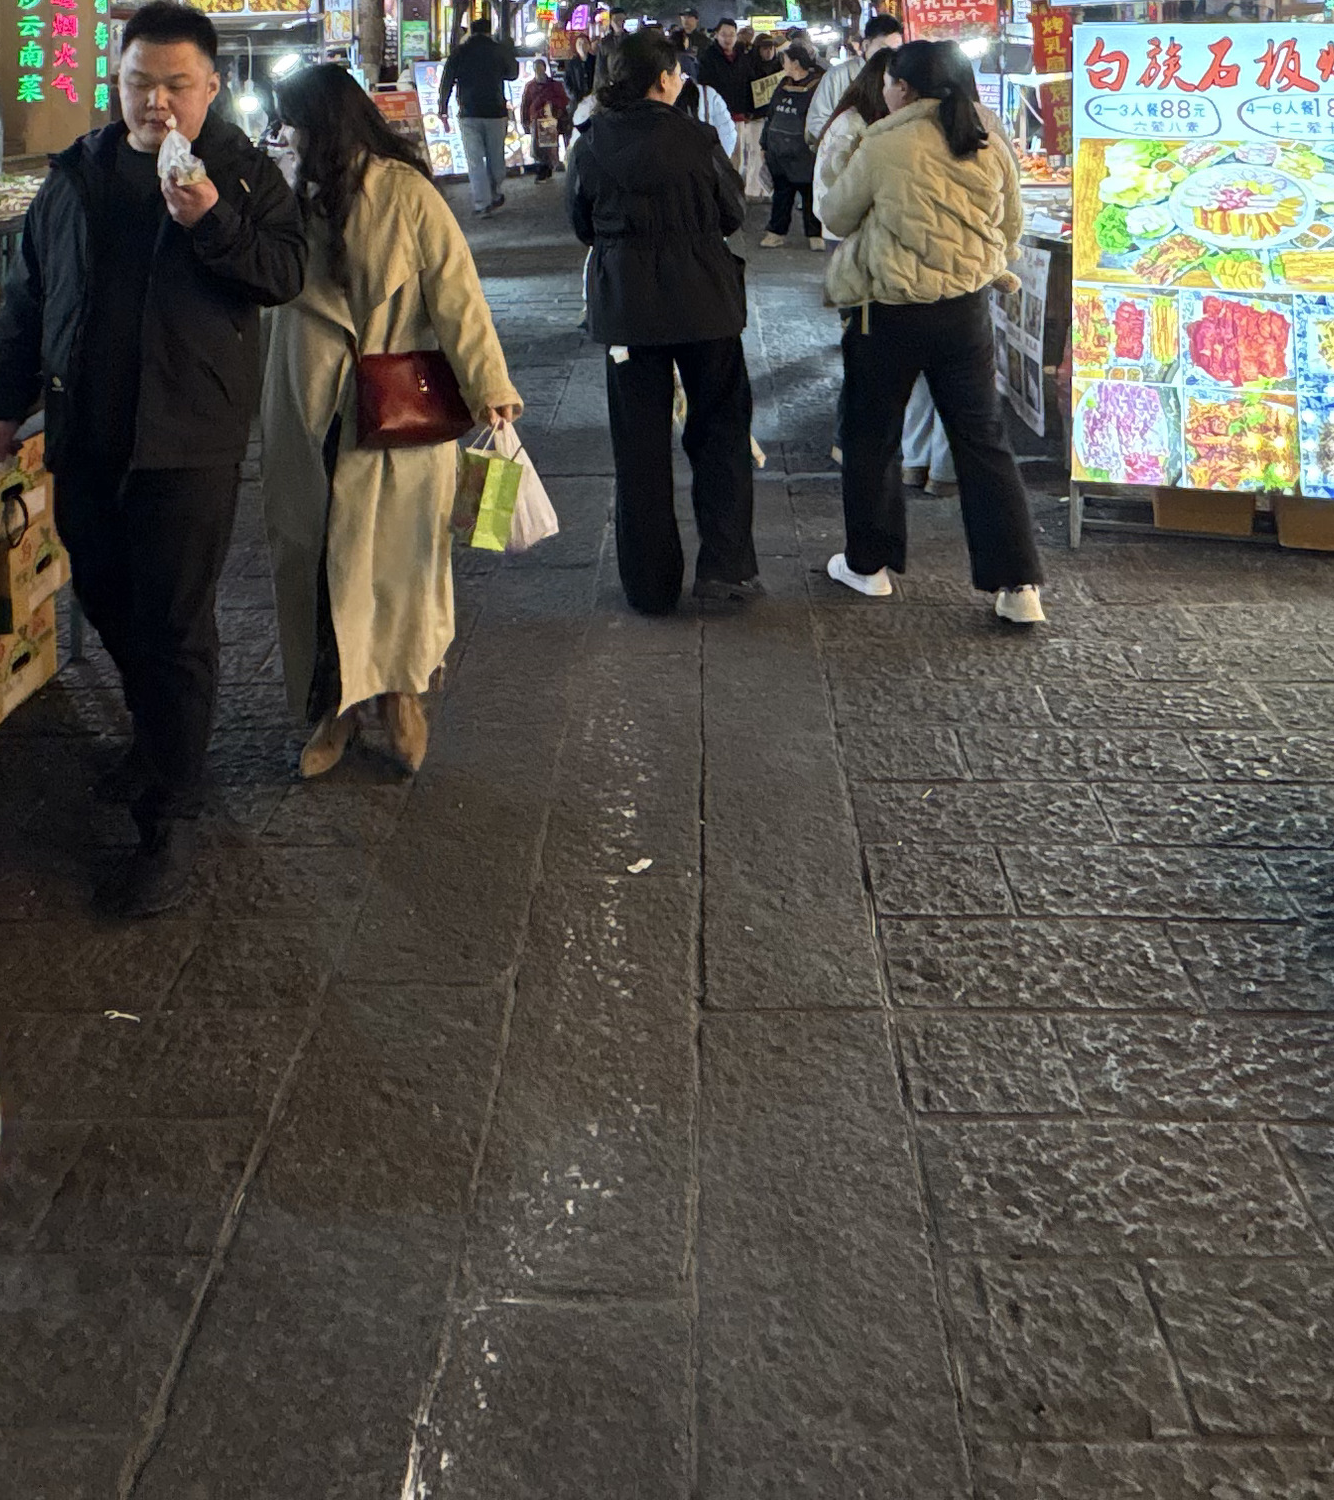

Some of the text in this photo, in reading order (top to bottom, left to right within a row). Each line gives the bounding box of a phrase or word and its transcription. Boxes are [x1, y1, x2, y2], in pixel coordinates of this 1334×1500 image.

[917, 8, 983, 23] 15元8个
[1040, 15, 1067, 73] 烤乳扇
